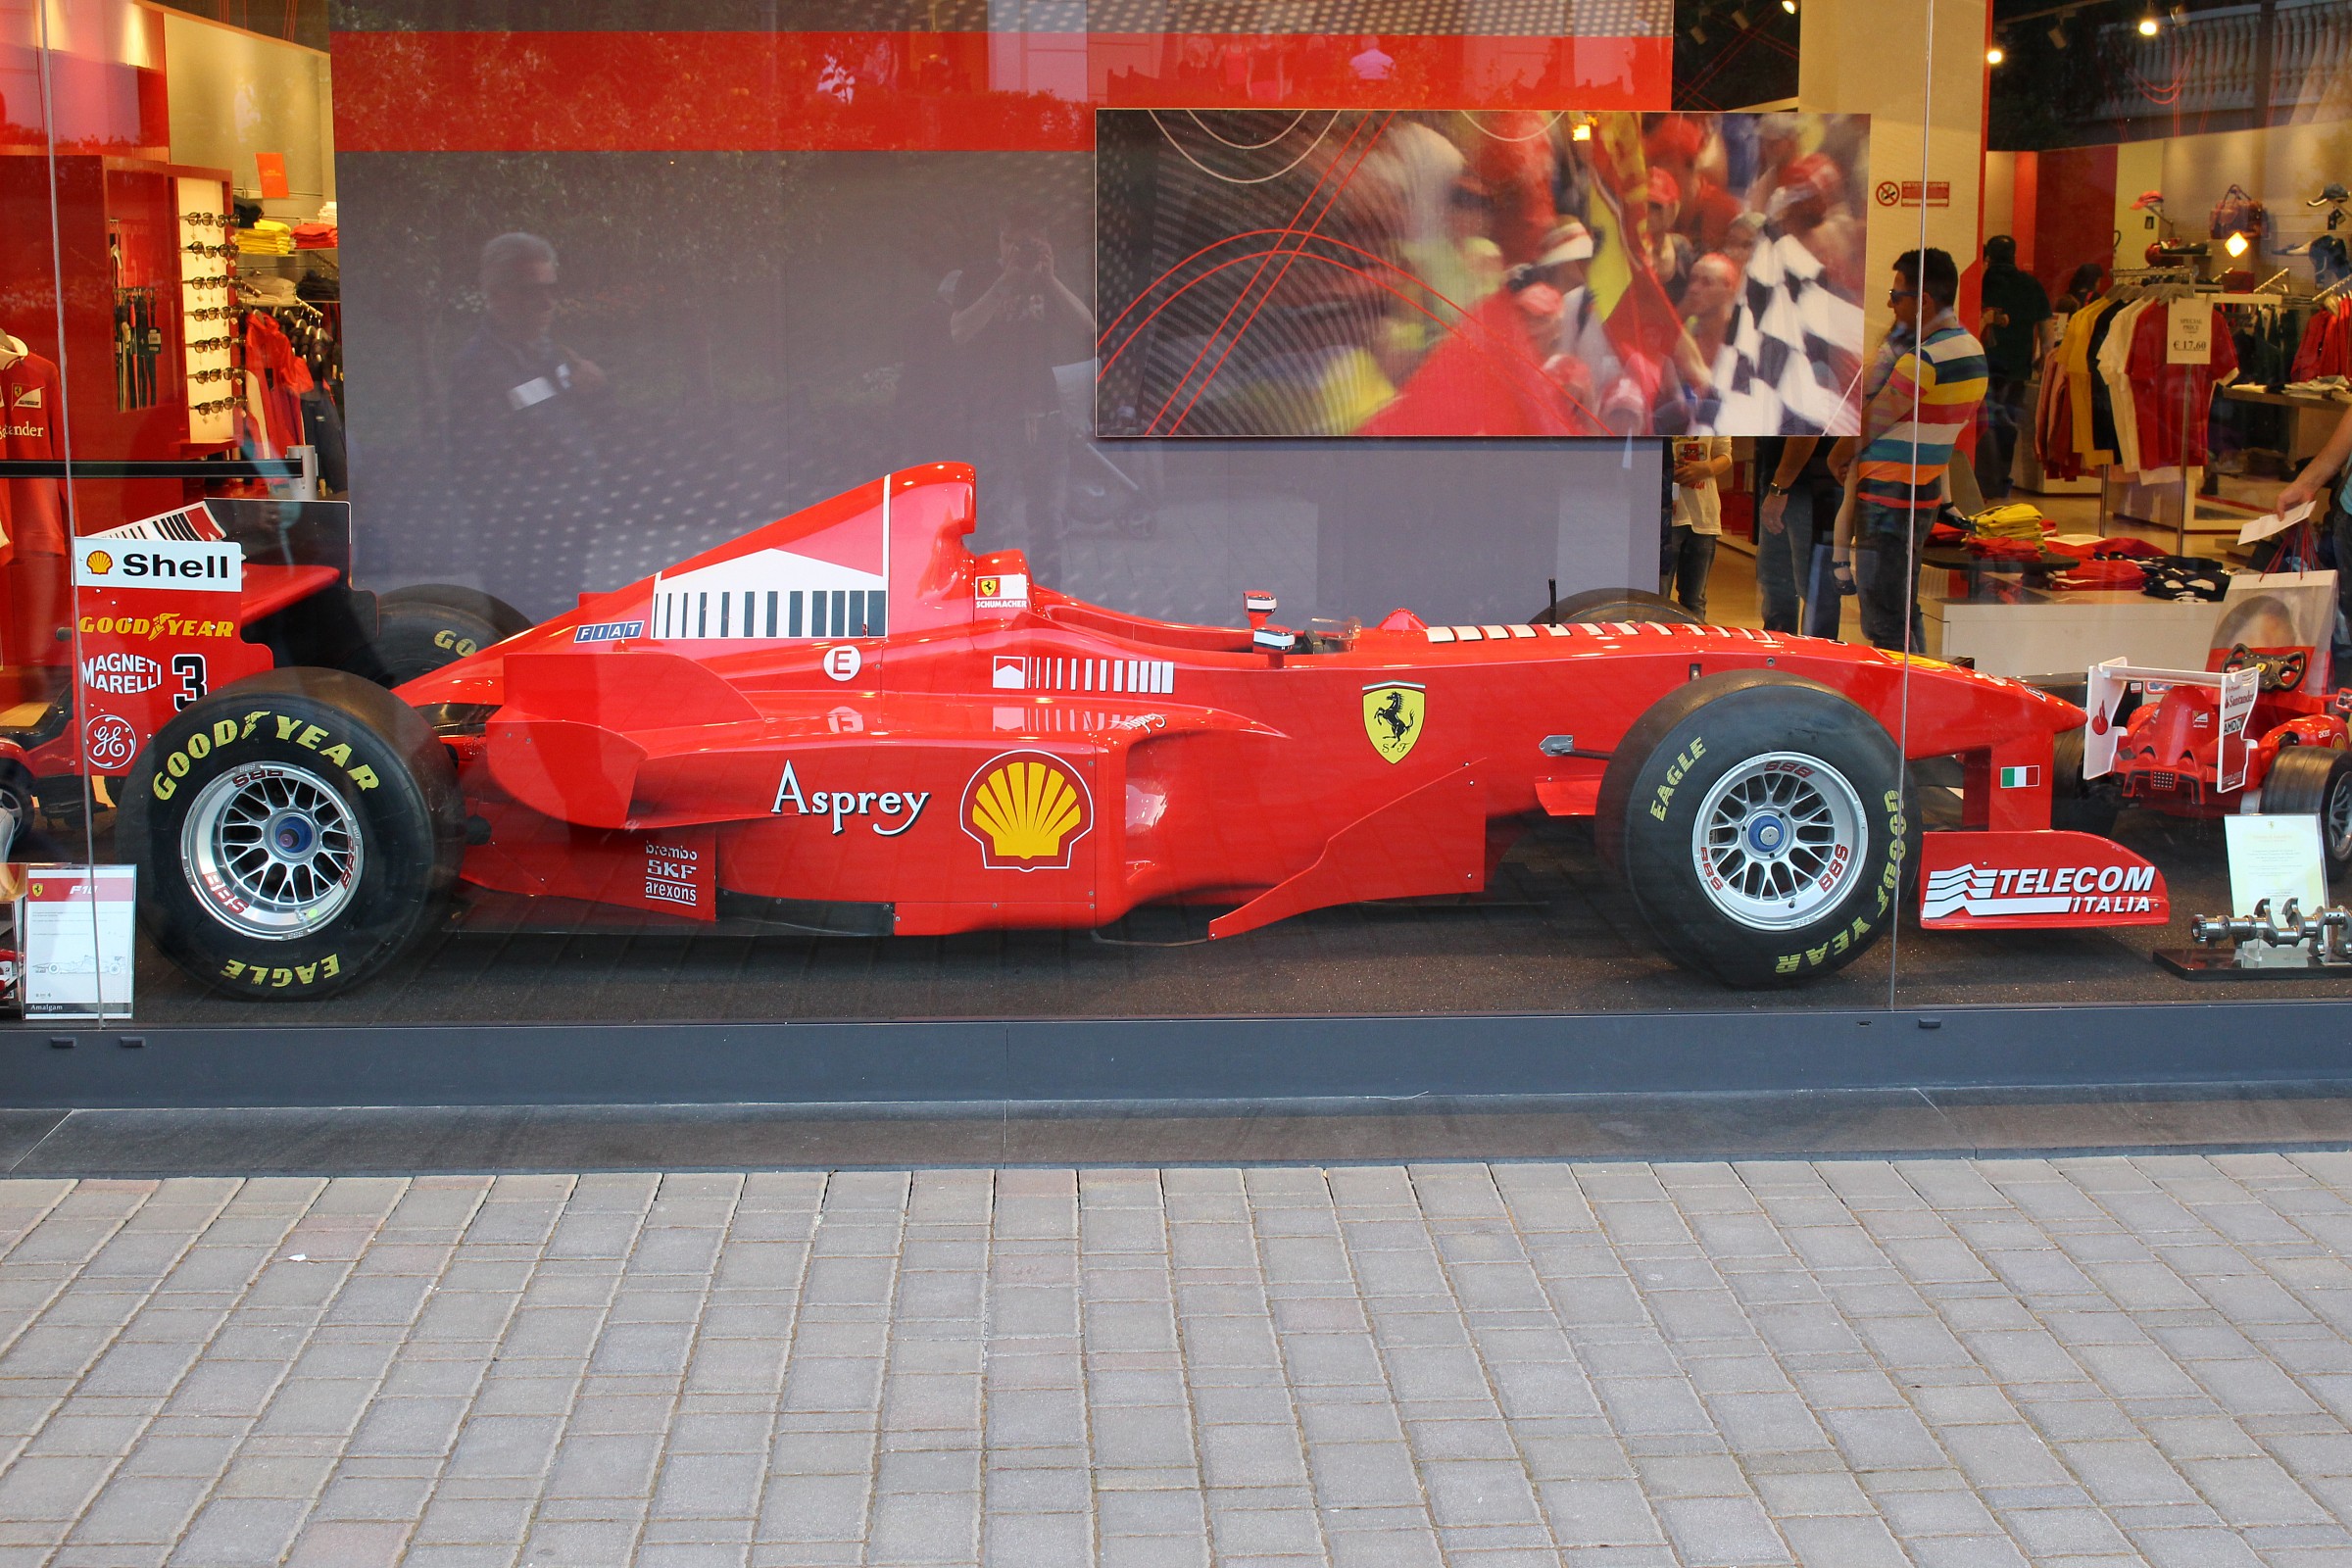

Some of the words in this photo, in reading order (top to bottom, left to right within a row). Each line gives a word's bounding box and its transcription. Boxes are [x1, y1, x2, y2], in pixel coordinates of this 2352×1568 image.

[122, 553, 228, 578] Shell
[976, 600, 1027, 609] SCHUMACHER
[580, 624, 639, 640] FIAT
[833, 651, 852, 674] E
[172, 654, 208, 712] 3
[1649, 736, 1707, 822] EAGLE
[1764, 761, 1815, 778] BBS
[770, 760, 932, 836] Asprey
[646, 840, 698, 860] brembo
[647, 858, 697, 879] SKF
[1819, 844, 1848, 892] BBS
[202, 870, 249, 914] BBS
[645, 881, 697, 902] arexons
[1999, 866, 2155, 895] TELECOM
[2073, 896, 2150, 913] ITALIA
[220, 953, 340, 988] EAGLE
[30, 1004, 63, 1012] Amalgam
